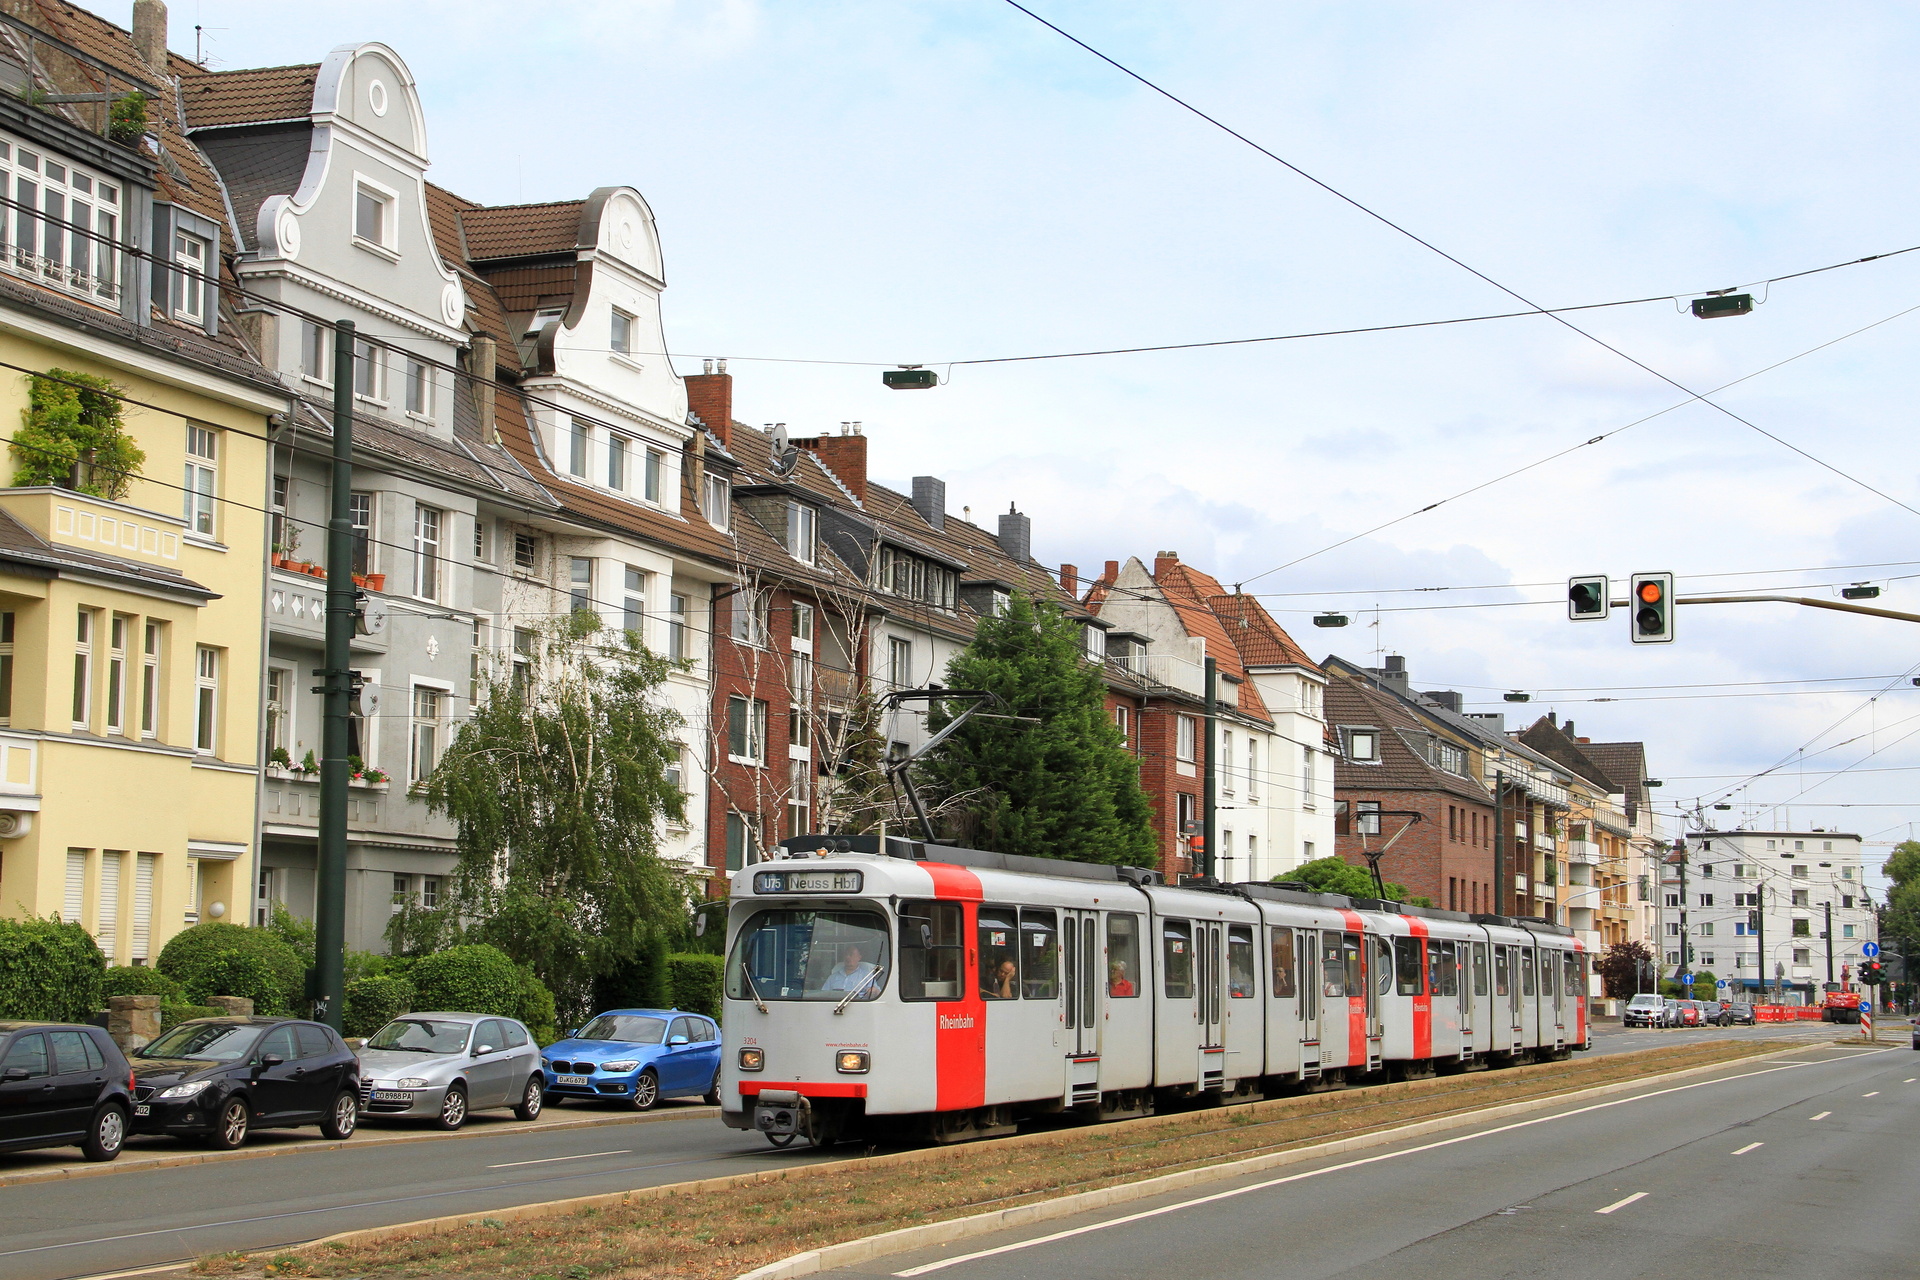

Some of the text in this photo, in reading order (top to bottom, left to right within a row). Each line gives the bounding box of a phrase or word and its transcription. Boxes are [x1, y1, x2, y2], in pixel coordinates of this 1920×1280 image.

[764, 877, 856, 889] U75 Neuss Hbf
[940, 1013, 974, 1029] Rheinbahn
[743, 1036, 757, 1045] 3204
